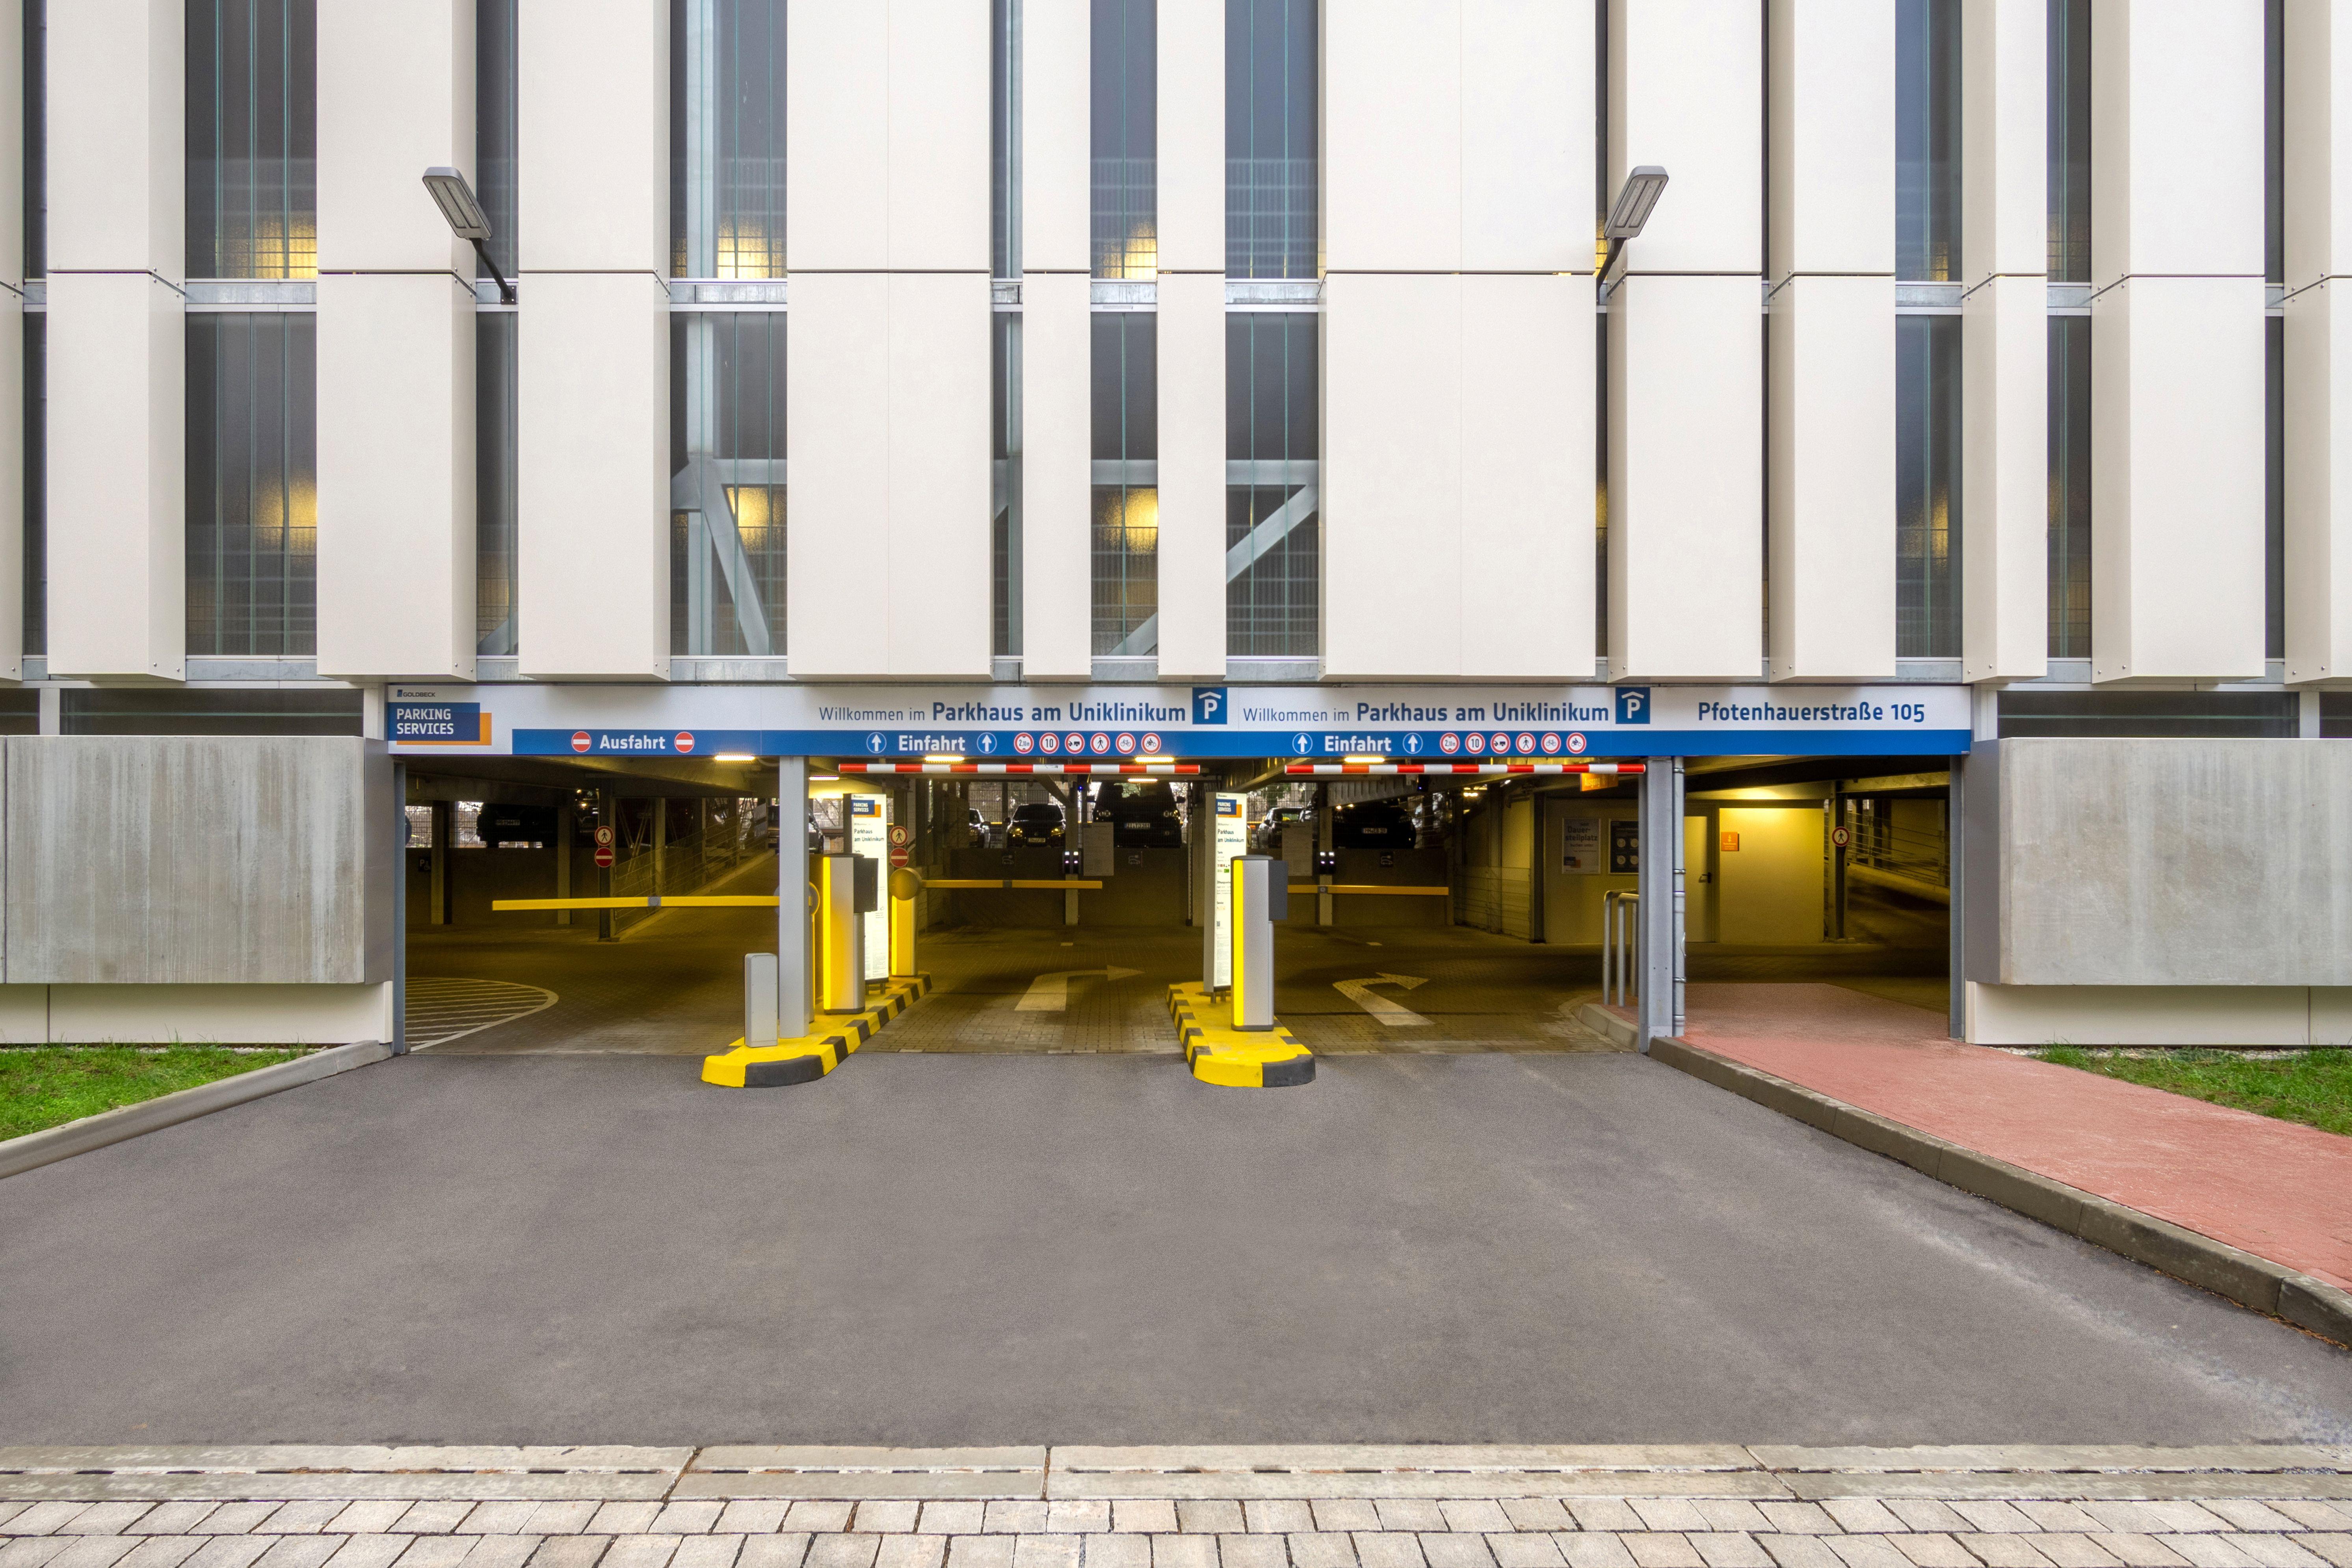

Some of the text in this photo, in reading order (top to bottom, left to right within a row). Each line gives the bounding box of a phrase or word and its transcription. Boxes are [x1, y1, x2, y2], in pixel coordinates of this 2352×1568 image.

[397, 709, 451, 720] PARKING
[819, 702, 1185, 721] Willkommen im Parkhaus am Uniklinikum
[1243, 702, 1608, 722] Willkommen im Parkhaus am Uniklinikum
[1699, 701, 1924, 723] Pfotenhauerstraße 105
[397, 723, 454, 735] SERVICES
[600, 735, 666, 749] Ausfahrt
[899, 735, 965, 751] Einfahrt
[1045, 738, 1054, 748] 10
[1324, 735, 1391, 752] Einfahrt
[1471, 738, 1480, 748] 10
